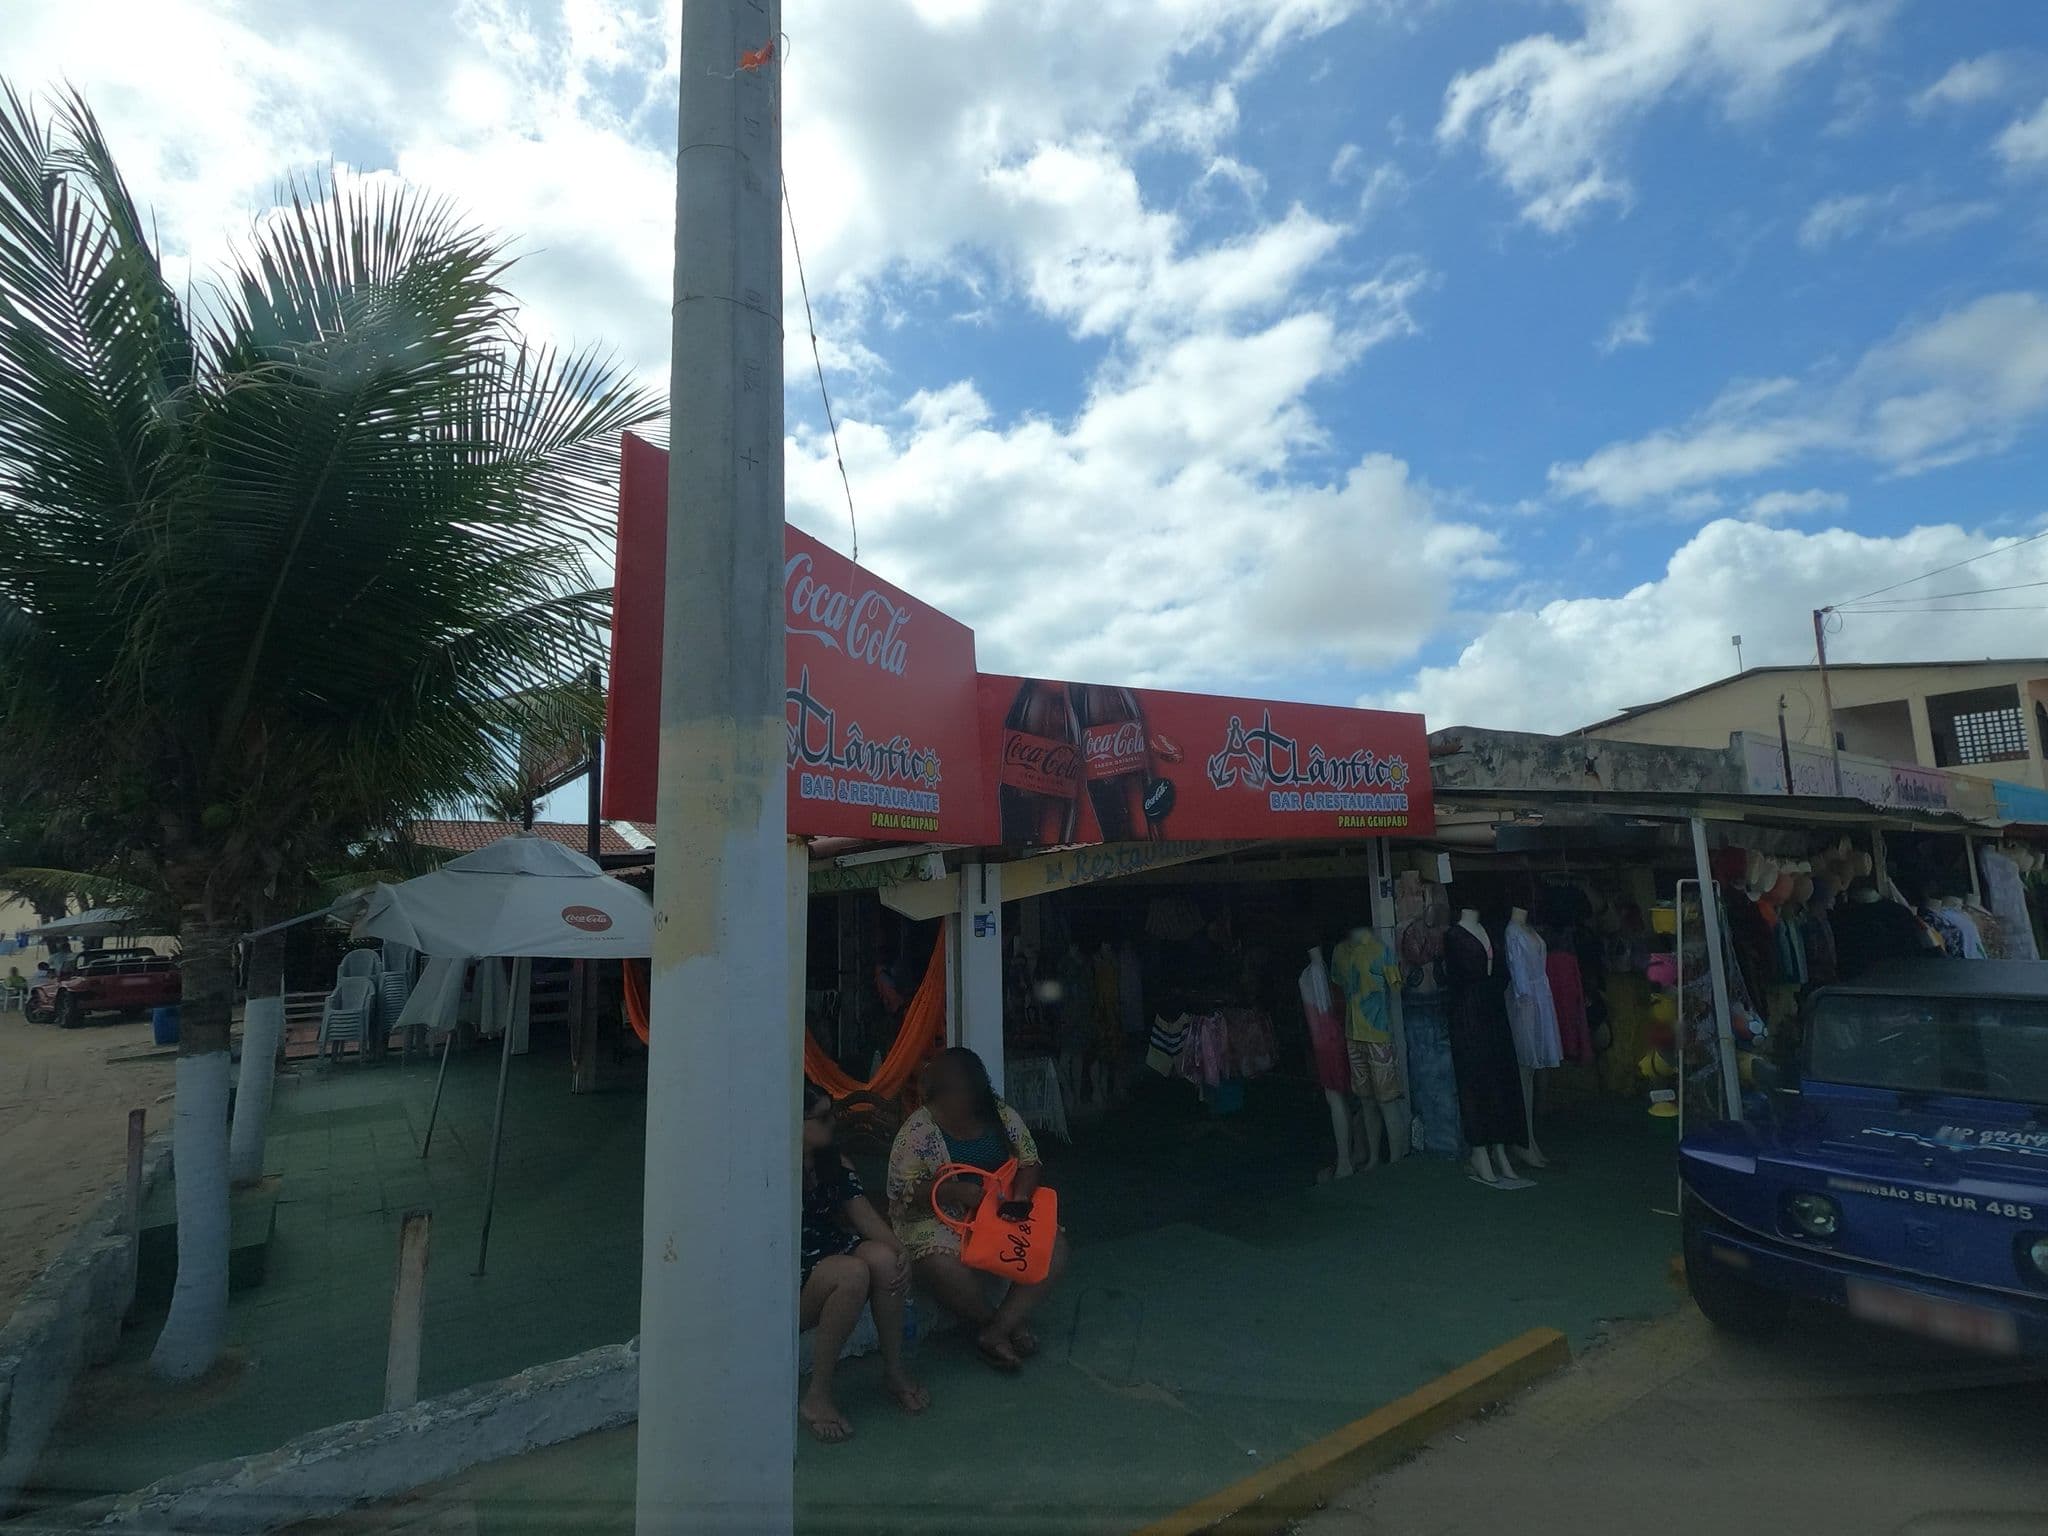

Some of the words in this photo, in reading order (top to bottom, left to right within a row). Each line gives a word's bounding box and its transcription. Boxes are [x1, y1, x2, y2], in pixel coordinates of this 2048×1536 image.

[800, 773, 835, 800] BAR
[838, 780, 849, 803] &
[848, 780, 940, 813] RESTAURANTE
[1270, 791, 1303, 811] BAR
[1304, 792, 1315, 811] &
[1315, 791, 1409, 811] RESTAURANTE
[871, 811, 899, 828] PRAIA
[901, 814, 939, 831] GENIPABU
[1338, 815, 1366, 827] PRAIA
[1367, 815, 1408, 827] GENIPABU
[1914, 1189, 1977, 1211] SETUR
[1986, 1200, 2034, 1221] 485
[1000, 1234, 1030, 1271] Sol
